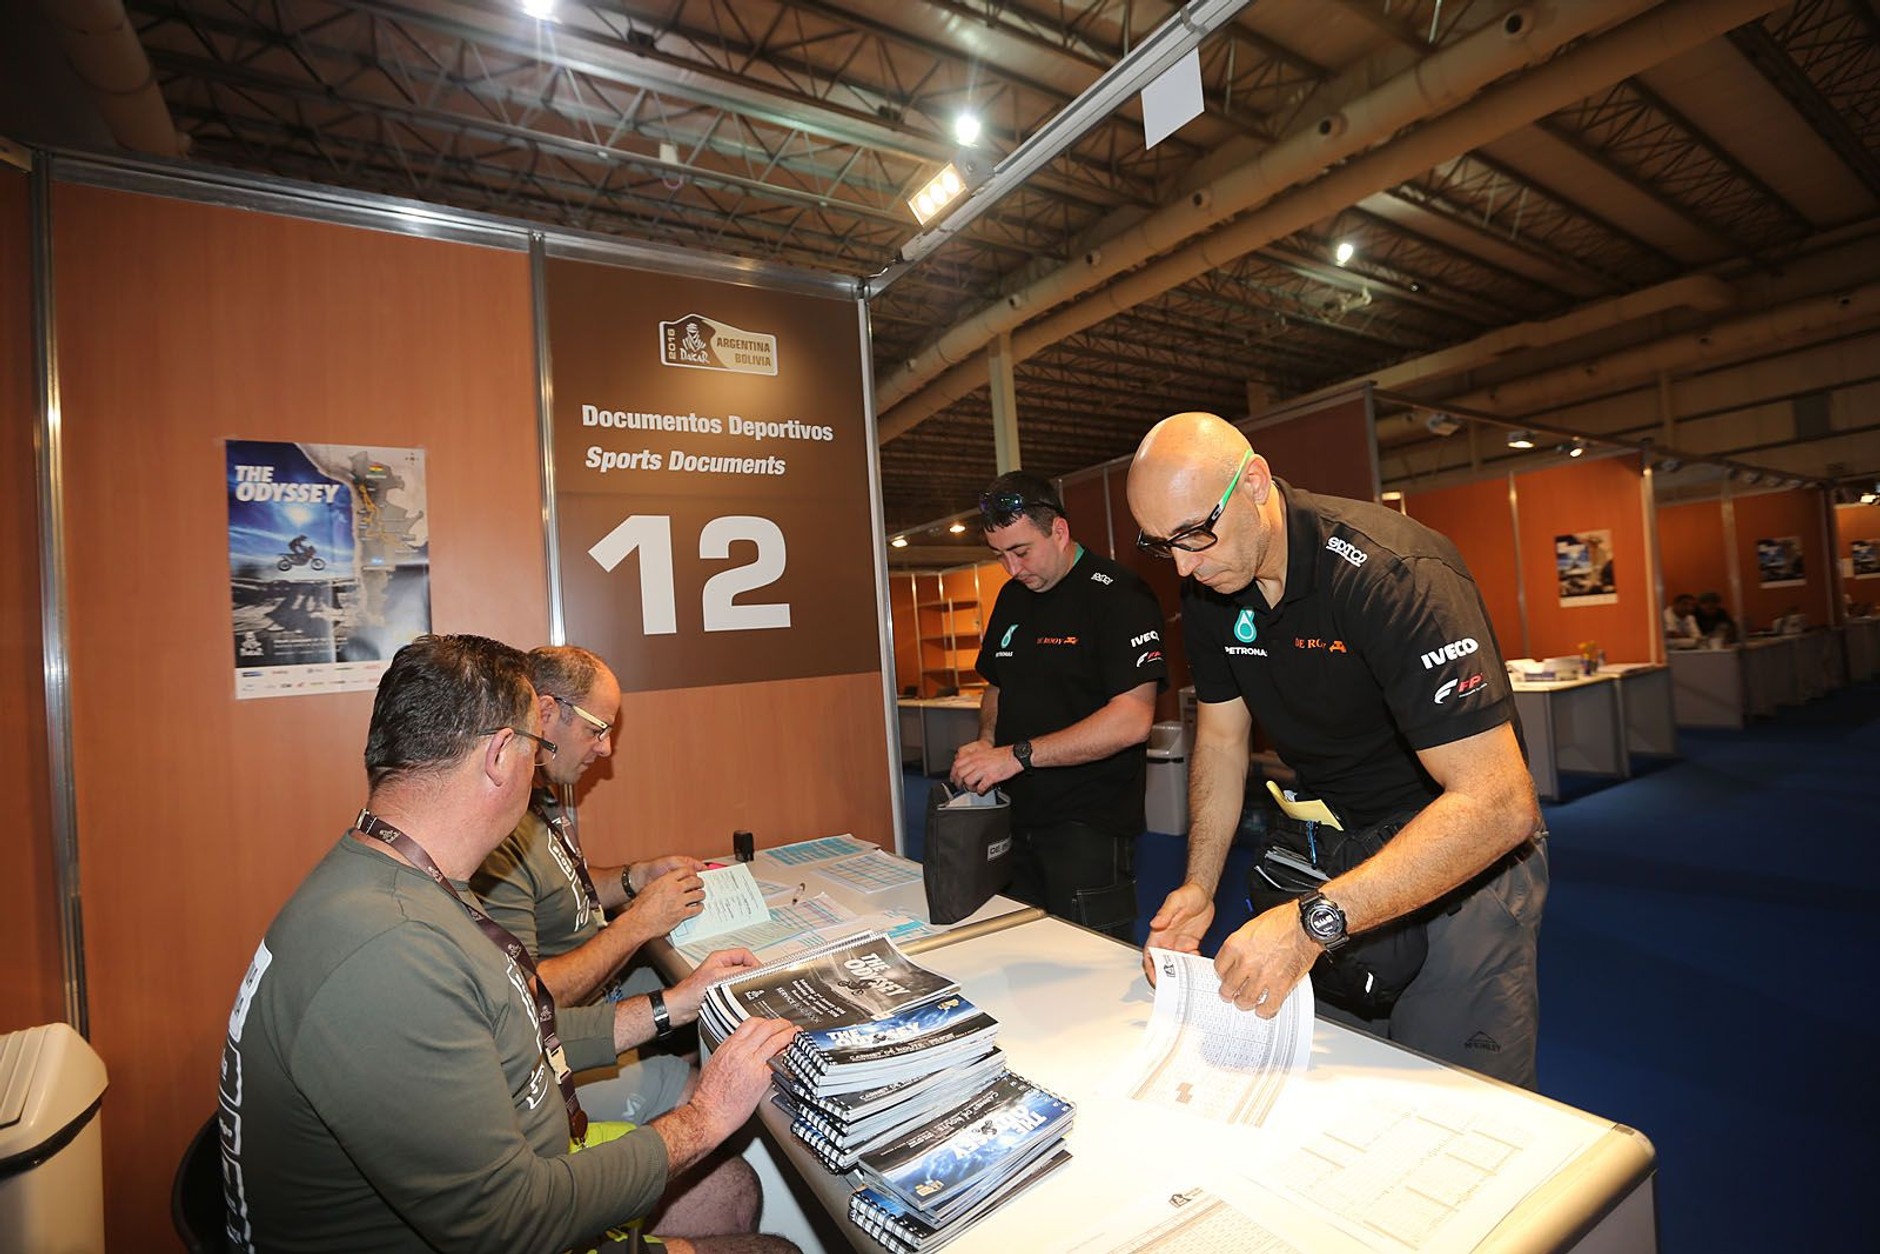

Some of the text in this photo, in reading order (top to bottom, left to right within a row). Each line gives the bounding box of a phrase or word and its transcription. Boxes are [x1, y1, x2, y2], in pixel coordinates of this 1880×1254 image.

[716, 337, 771, 352] ARGENTINA
[735, 352, 771, 367] BOLIVIA
[582, 404, 834, 441] Documentos Deportivos
[585, 446, 786, 475] Sports Documents
[235, 465, 274, 482] THE
[236, 481, 340, 503] ODYSSEY
[587, 514, 791, 635] 12
[1421, 637, 1479, 670] IVECO
[861, 952, 892, 973] THE
[826, 1029, 859, 1041] THE
